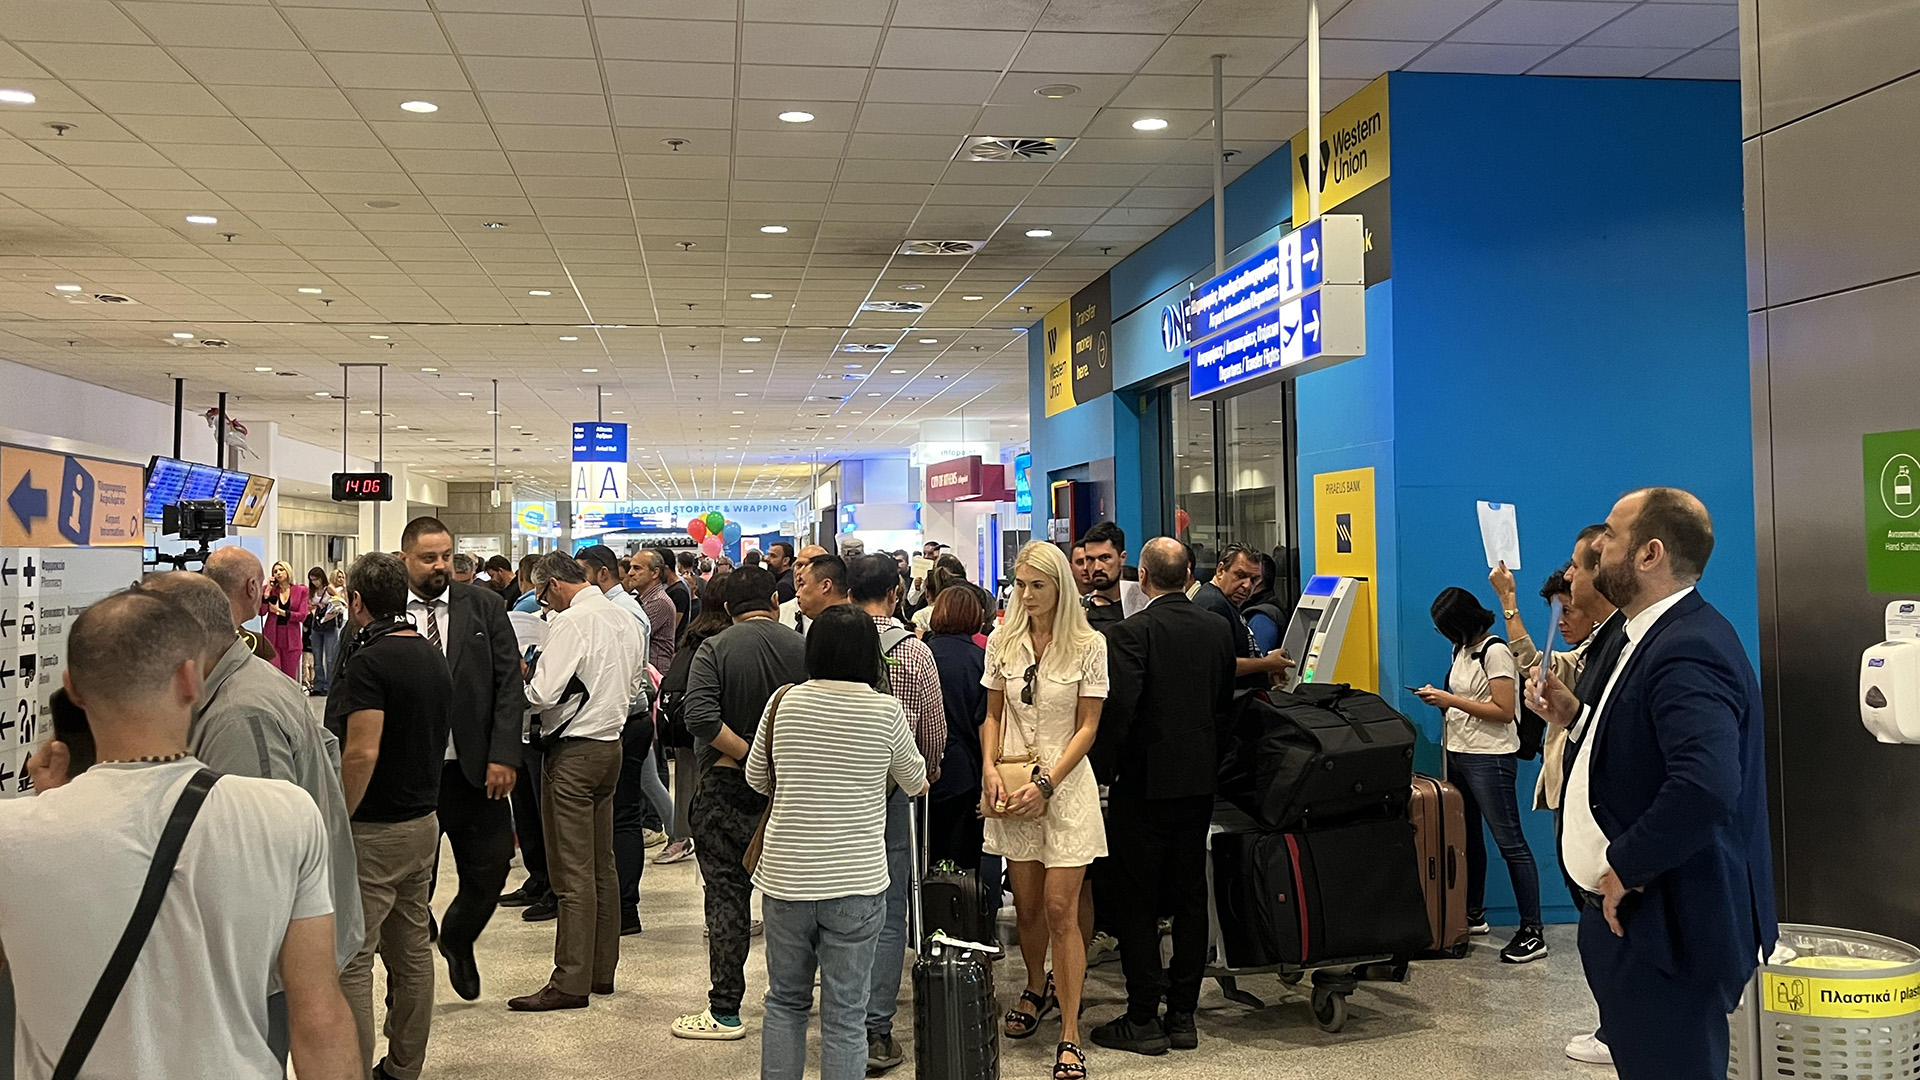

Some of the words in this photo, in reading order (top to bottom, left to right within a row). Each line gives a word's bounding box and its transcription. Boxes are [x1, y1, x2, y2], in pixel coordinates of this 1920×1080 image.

[1333, 112, 1381, 157] Western
[1333, 149, 1368, 184] Union
[1075, 304, 1097, 327] Transfer
[1075, 334, 1093, 354] money
[1049, 360, 1067, 381] Western
[1049, 382, 1062, 399] Union
[599, 467, 619, 498] A
[1326, 482, 1346, 495] PIRAEUS
[1347, 480, 1361, 493] BANK
[619, 506, 670, 514] BAGGAGE
[674, 505, 720, 513] STORAGE
[733, 504, 787, 512] WRAPPING
[1820, 989, 1890, 1004] Πλαστικά
